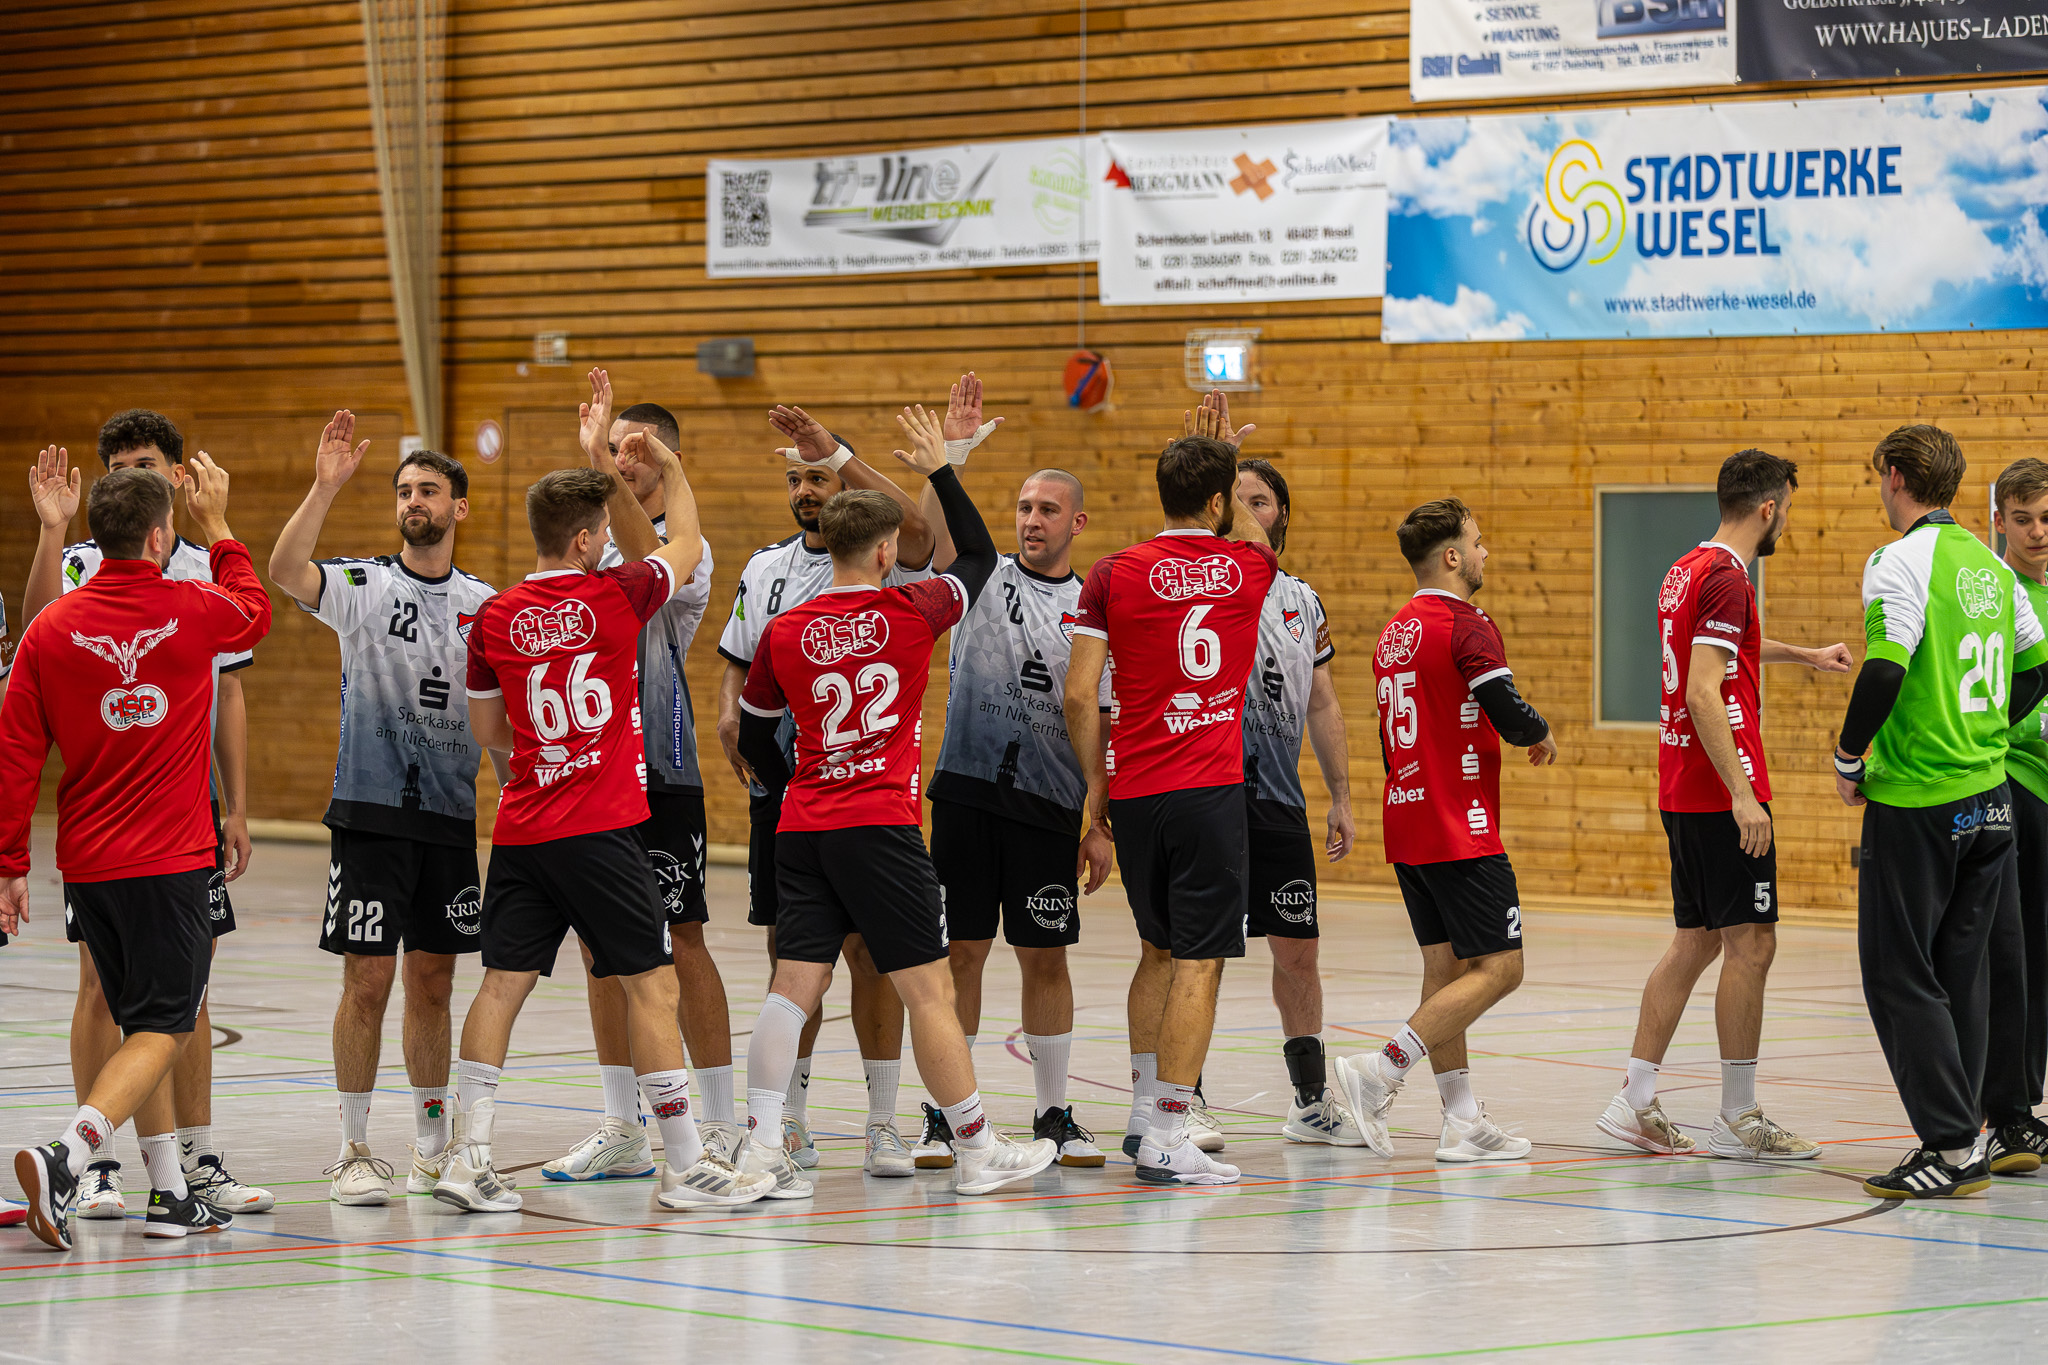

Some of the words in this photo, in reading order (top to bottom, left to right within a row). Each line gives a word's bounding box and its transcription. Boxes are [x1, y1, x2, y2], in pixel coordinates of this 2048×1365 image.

[1486, 5, 1541, 20] SERVICE
[1491, 27, 1560, 42] WARTUNG
[1625, 146, 1902, 203] STADTWERKE
[1637, 208, 1781, 258] WESEL
[1604, 290, 1817, 314] www.stadtwerke-wesel.de
[1160, 562, 1231, 589] HSG
[1169, 581, 1221, 597] WESEL
[766, 577, 786, 616] 8
[519, 610, 584, 642] HSG
[812, 619, 877, 651] HSG
[529, 630, 577, 652] WESEL
[820, 637, 869, 660] WESEL
[1177, 604, 1222, 682] 6
[1661, 618, 1679, 695] 5
[1959, 631, 2006, 713] 20
[109, 694, 157, 718] HSG
[526, 651, 613, 745] 66
[811, 662, 900, 752] 22
[979, 700, 1001, 716] am
[1377, 670, 1418, 752] 25
[115, 710, 155, 726] WESEL
[398, 706, 466, 732] Sparkasse
[375, 725, 397, 743] am
[1025, 896, 1074, 911] KRINK
[1754, 882, 1770, 913] 5
[348, 899, 384, 941] 22
[1036, 913, 1067, 927] LIQUEURS
[1507, 904, 1522, 939] 2
